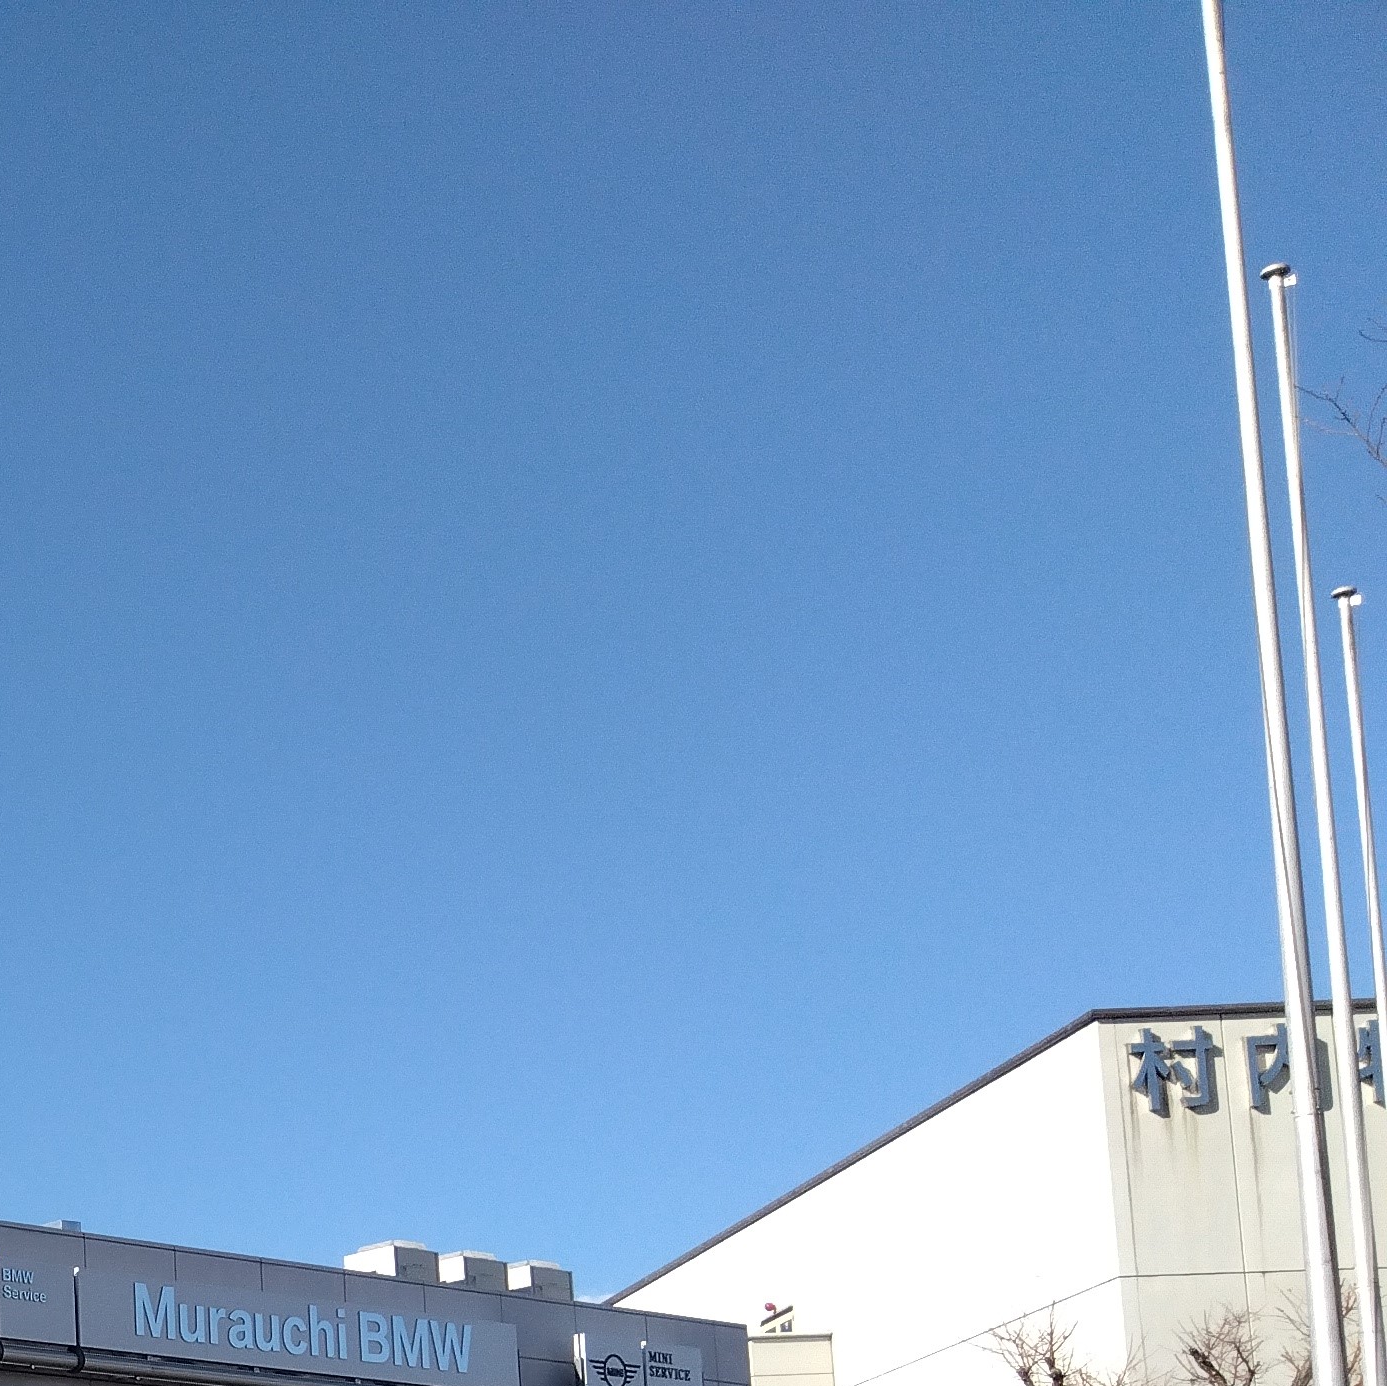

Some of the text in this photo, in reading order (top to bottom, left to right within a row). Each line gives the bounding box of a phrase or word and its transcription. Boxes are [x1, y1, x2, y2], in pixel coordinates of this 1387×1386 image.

[2, 1268, 34, 1284] BMW
[2, 1285, 47, 1303] Service
[133, 1282, 472, 1374] Murauchi BMW
[648, 1351, 673, 1365] MINI
[649, 1365, 691, 1381] SERVICE
